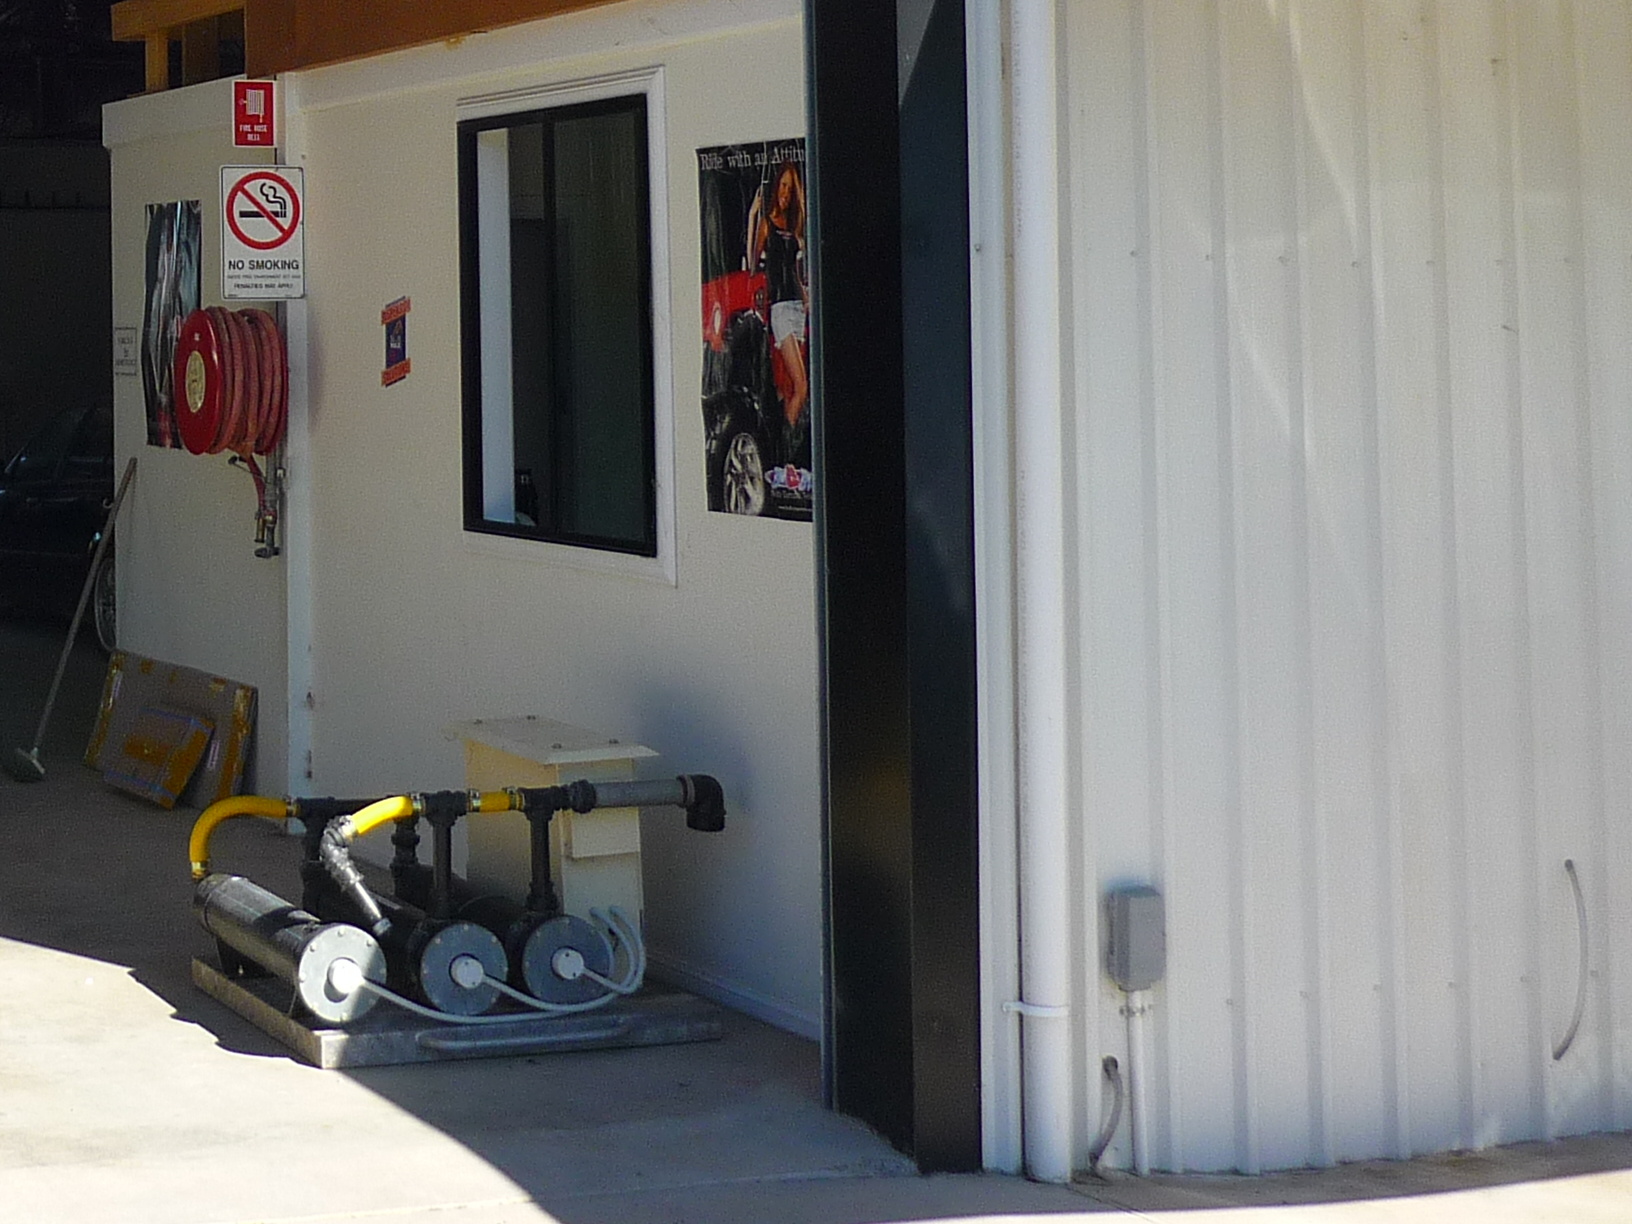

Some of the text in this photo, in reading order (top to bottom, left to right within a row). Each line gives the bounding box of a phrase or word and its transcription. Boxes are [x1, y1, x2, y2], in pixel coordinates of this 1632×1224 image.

[699, 153, 723, 171] Ride
[727, 151, 752, 168] with
[754, 152, 768, 166] an
[228, 259, 299, 271] NO SMOKING
